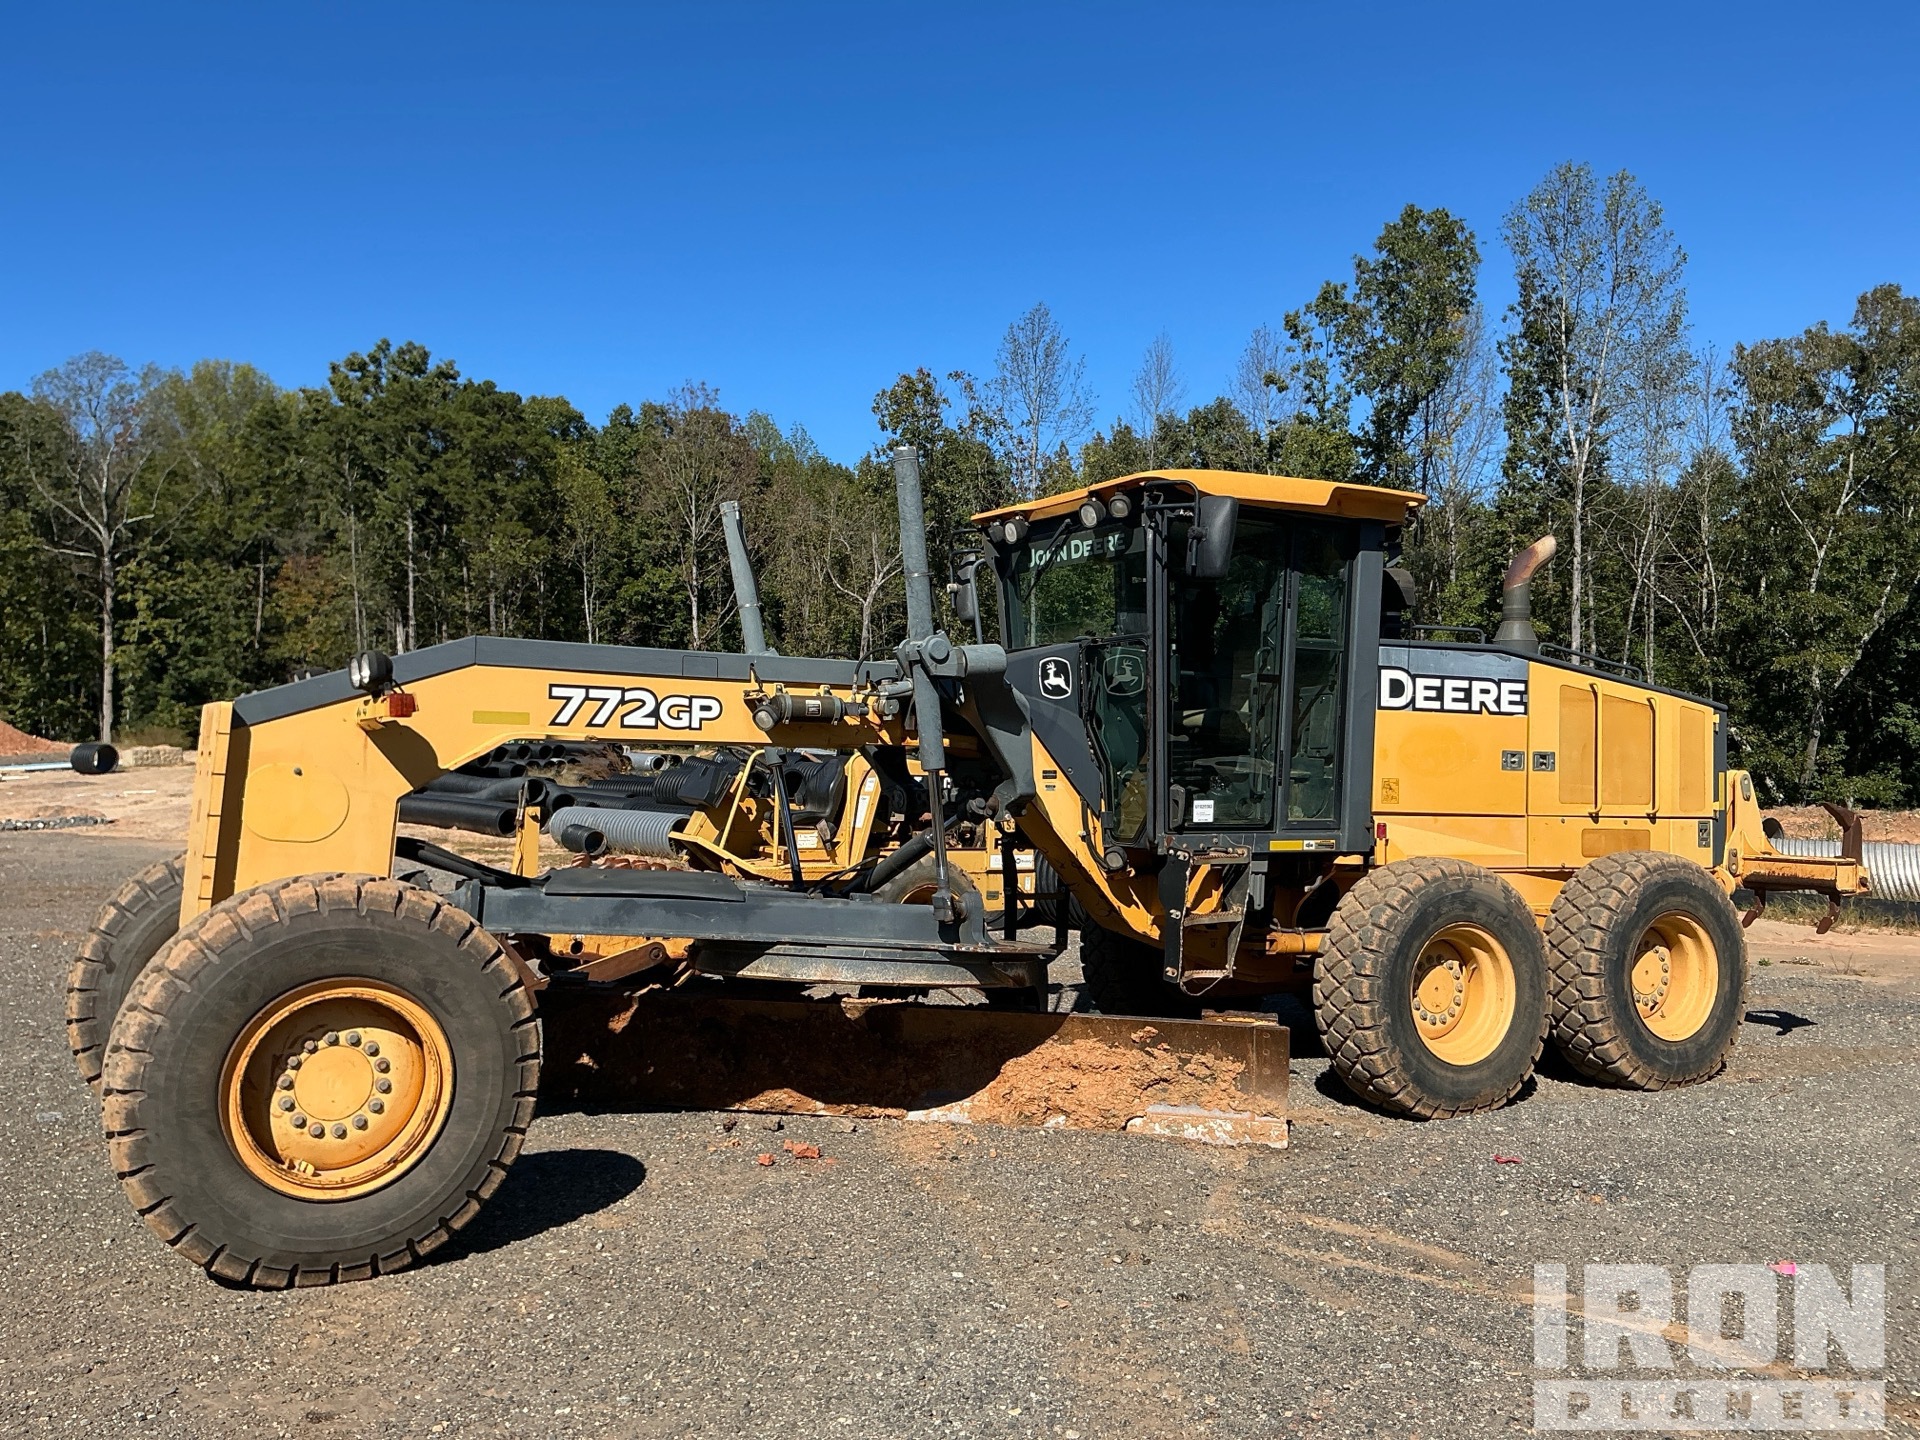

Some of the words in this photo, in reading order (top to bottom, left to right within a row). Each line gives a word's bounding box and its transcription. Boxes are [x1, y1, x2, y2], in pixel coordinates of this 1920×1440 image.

[1070, 533, 1125, 559] DEERE
[549, 684, 722, 730] 772GP
[1379, 667, 1526, 714] DEERE
